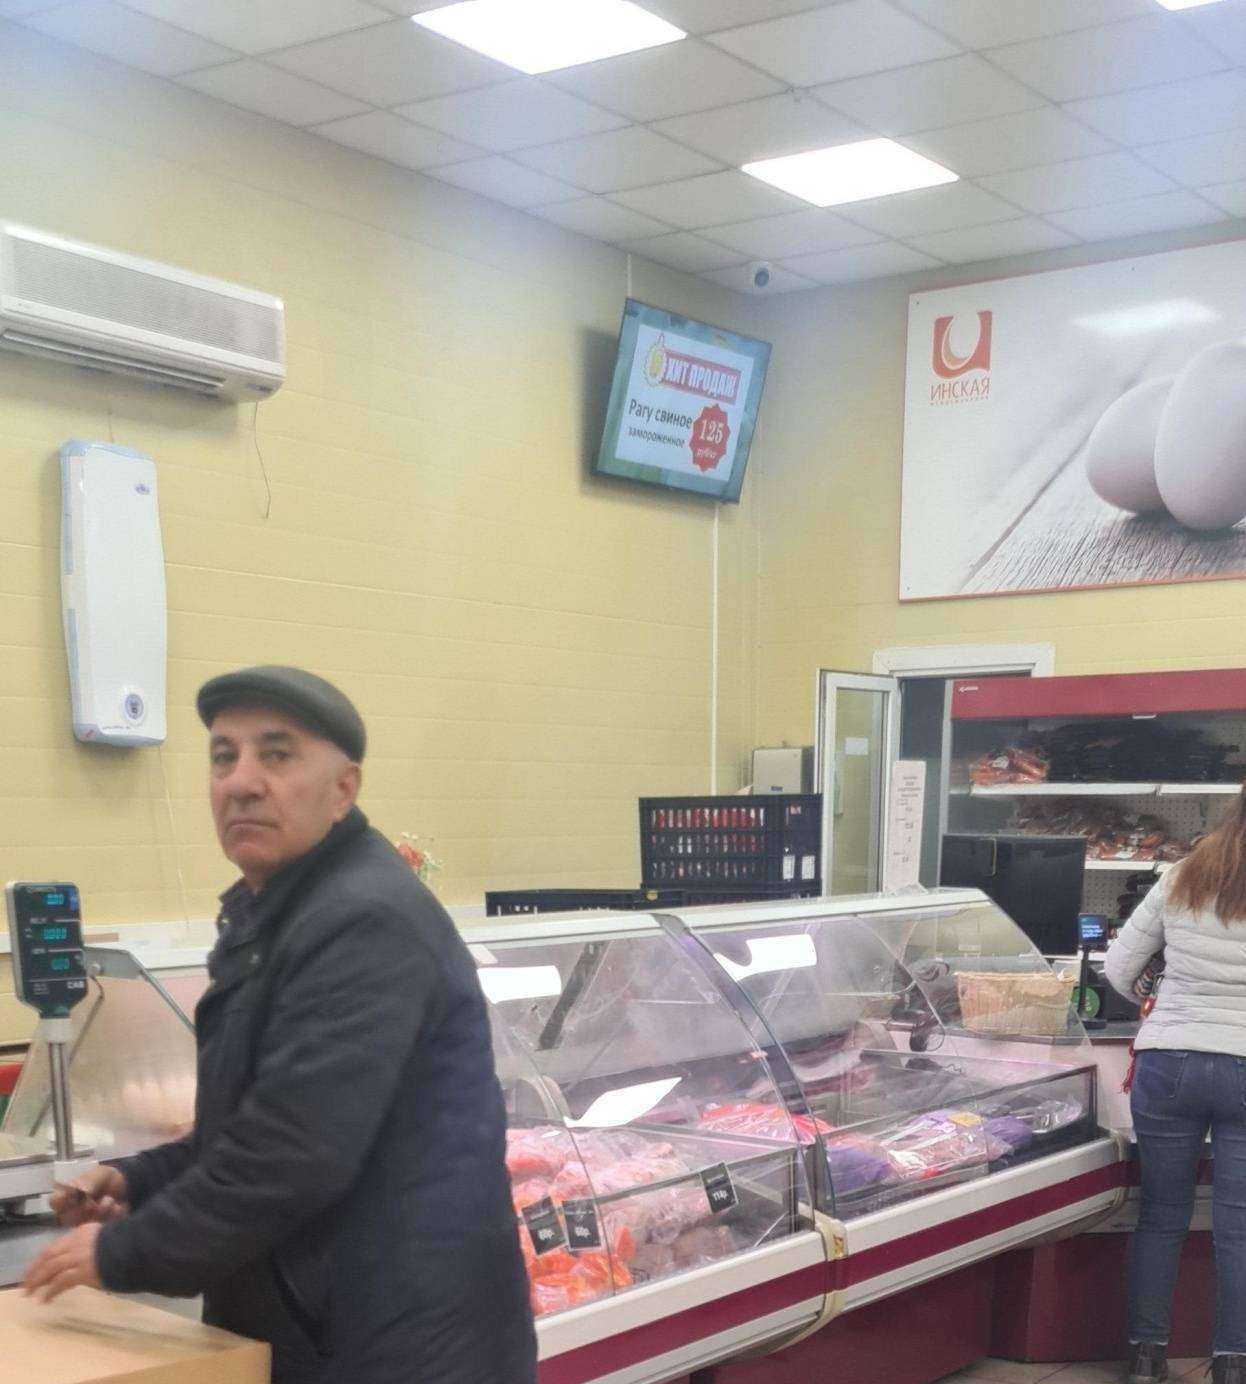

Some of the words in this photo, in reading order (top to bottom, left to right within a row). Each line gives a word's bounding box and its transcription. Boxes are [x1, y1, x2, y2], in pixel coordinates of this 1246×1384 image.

[667, 358, 689, 384] ХИТ
[689, 364, 737, 397] ПРОДАЖ
[931, 376, 990, 400] ИНСКАЯ
[629, 399, 653, 422] Рагу
[655, 410, 692, 430] свиное
[628, 428, 685, 447] замороженное
[700, 419, 724, 443] 125
